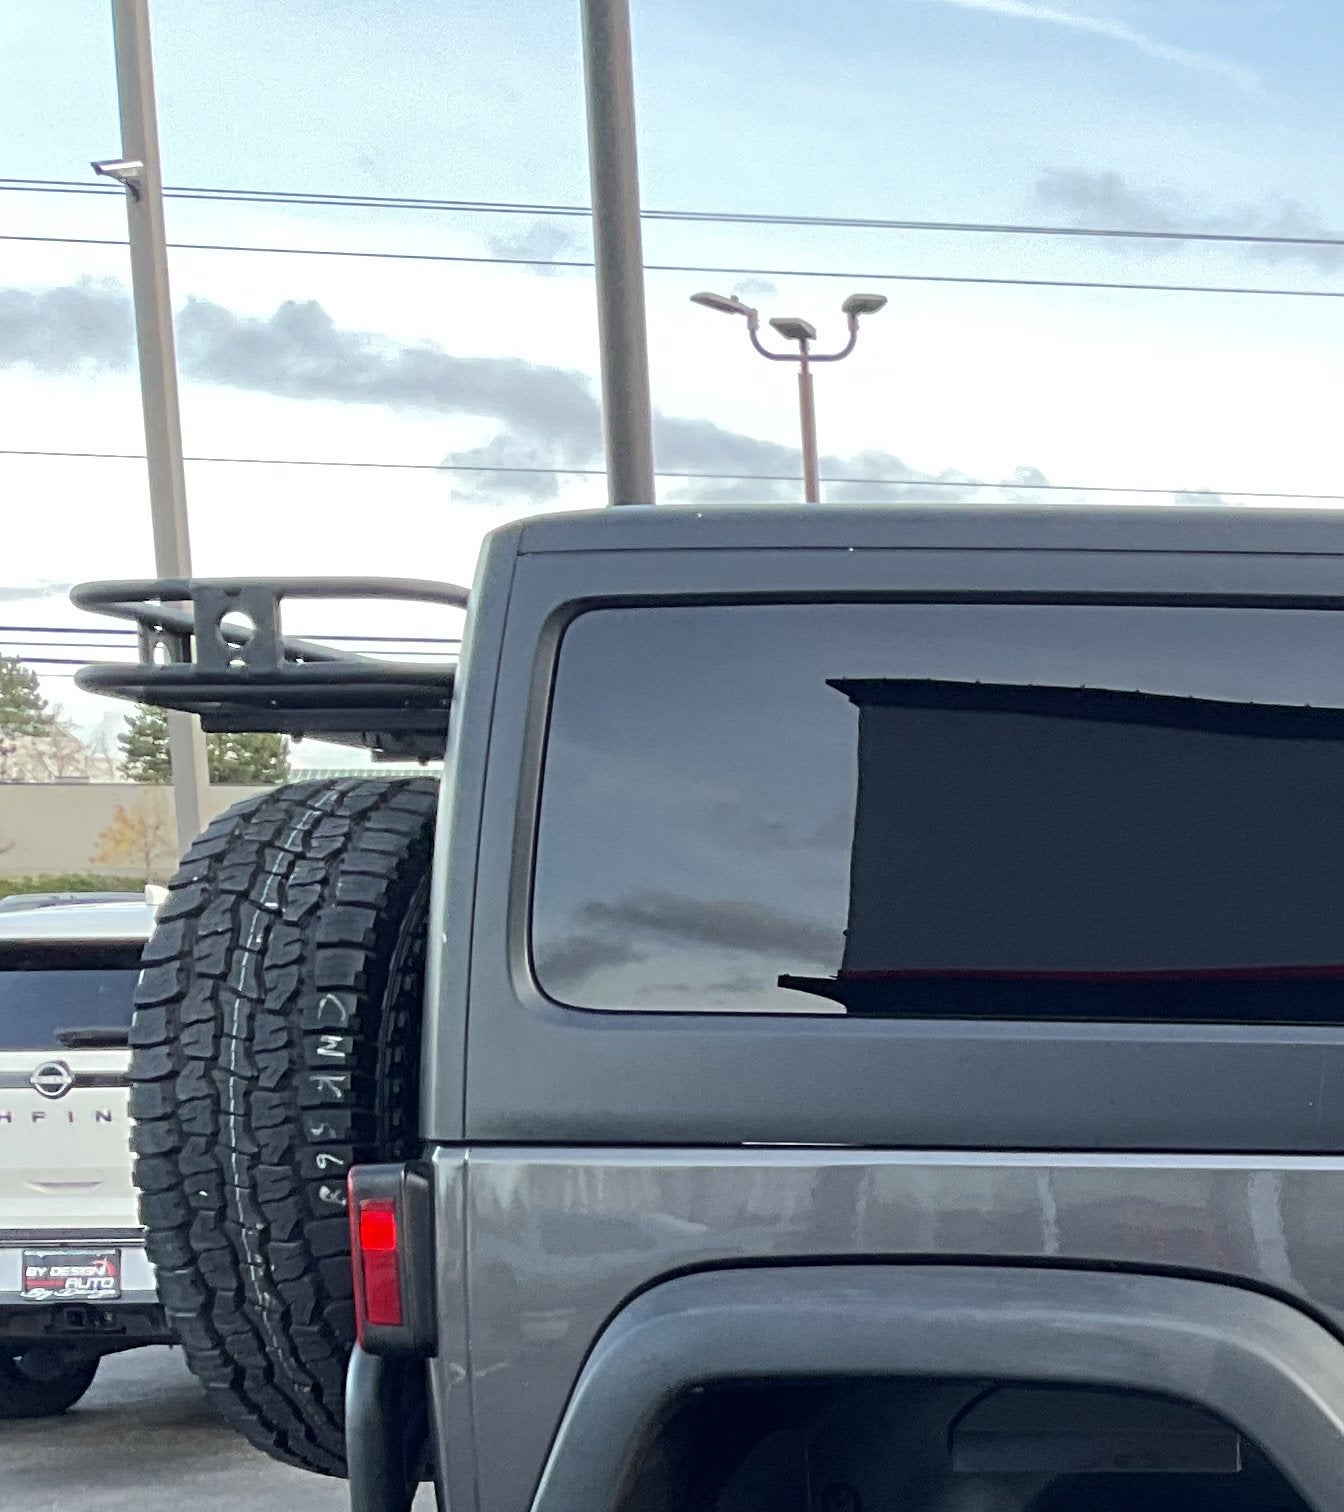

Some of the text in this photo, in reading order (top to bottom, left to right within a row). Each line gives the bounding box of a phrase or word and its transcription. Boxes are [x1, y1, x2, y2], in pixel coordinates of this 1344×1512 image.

[26, 1263, 107, 1277] BY DESIGN
[65, 1277, 115, 1290] AUTO
